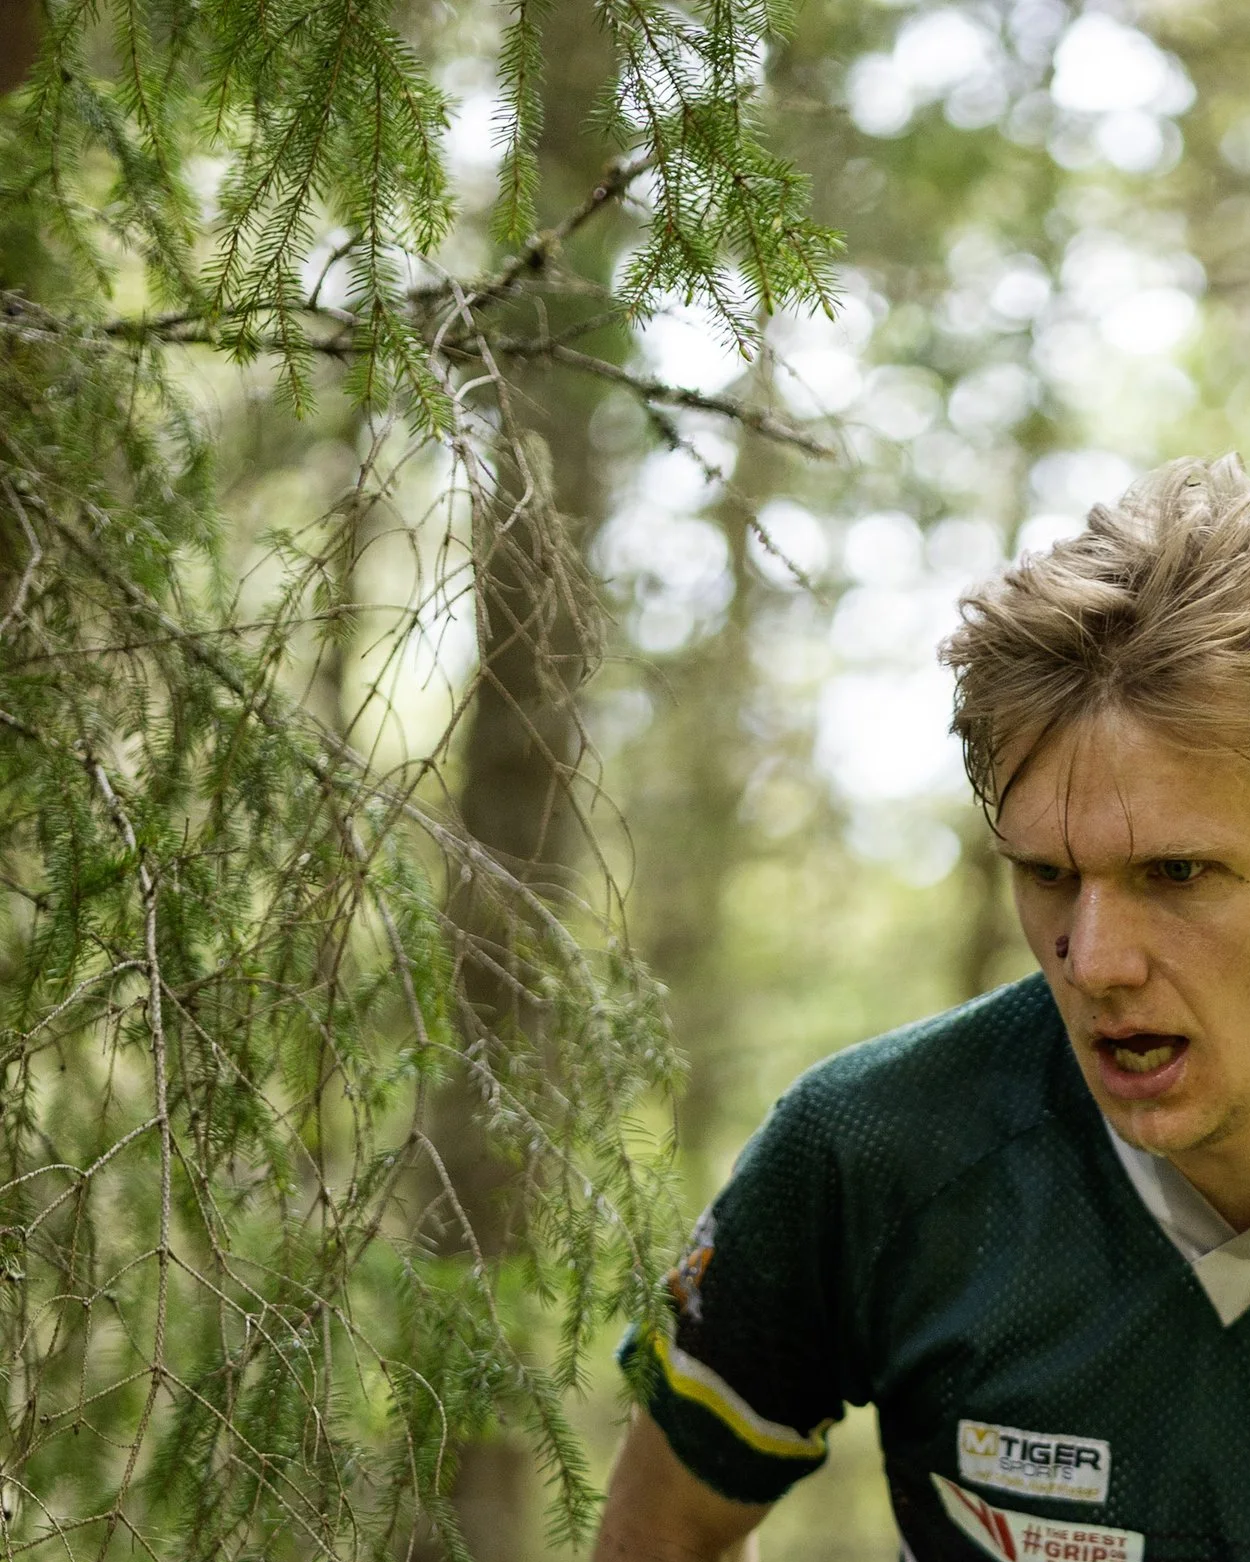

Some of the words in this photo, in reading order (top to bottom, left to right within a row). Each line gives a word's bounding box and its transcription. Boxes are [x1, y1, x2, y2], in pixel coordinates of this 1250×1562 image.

[1000, 1435, 1102, 1471] TIGER
[999, 1456, 1075, 1481] SPORTS
[1073, 1531, 1127, 1547] BEST
